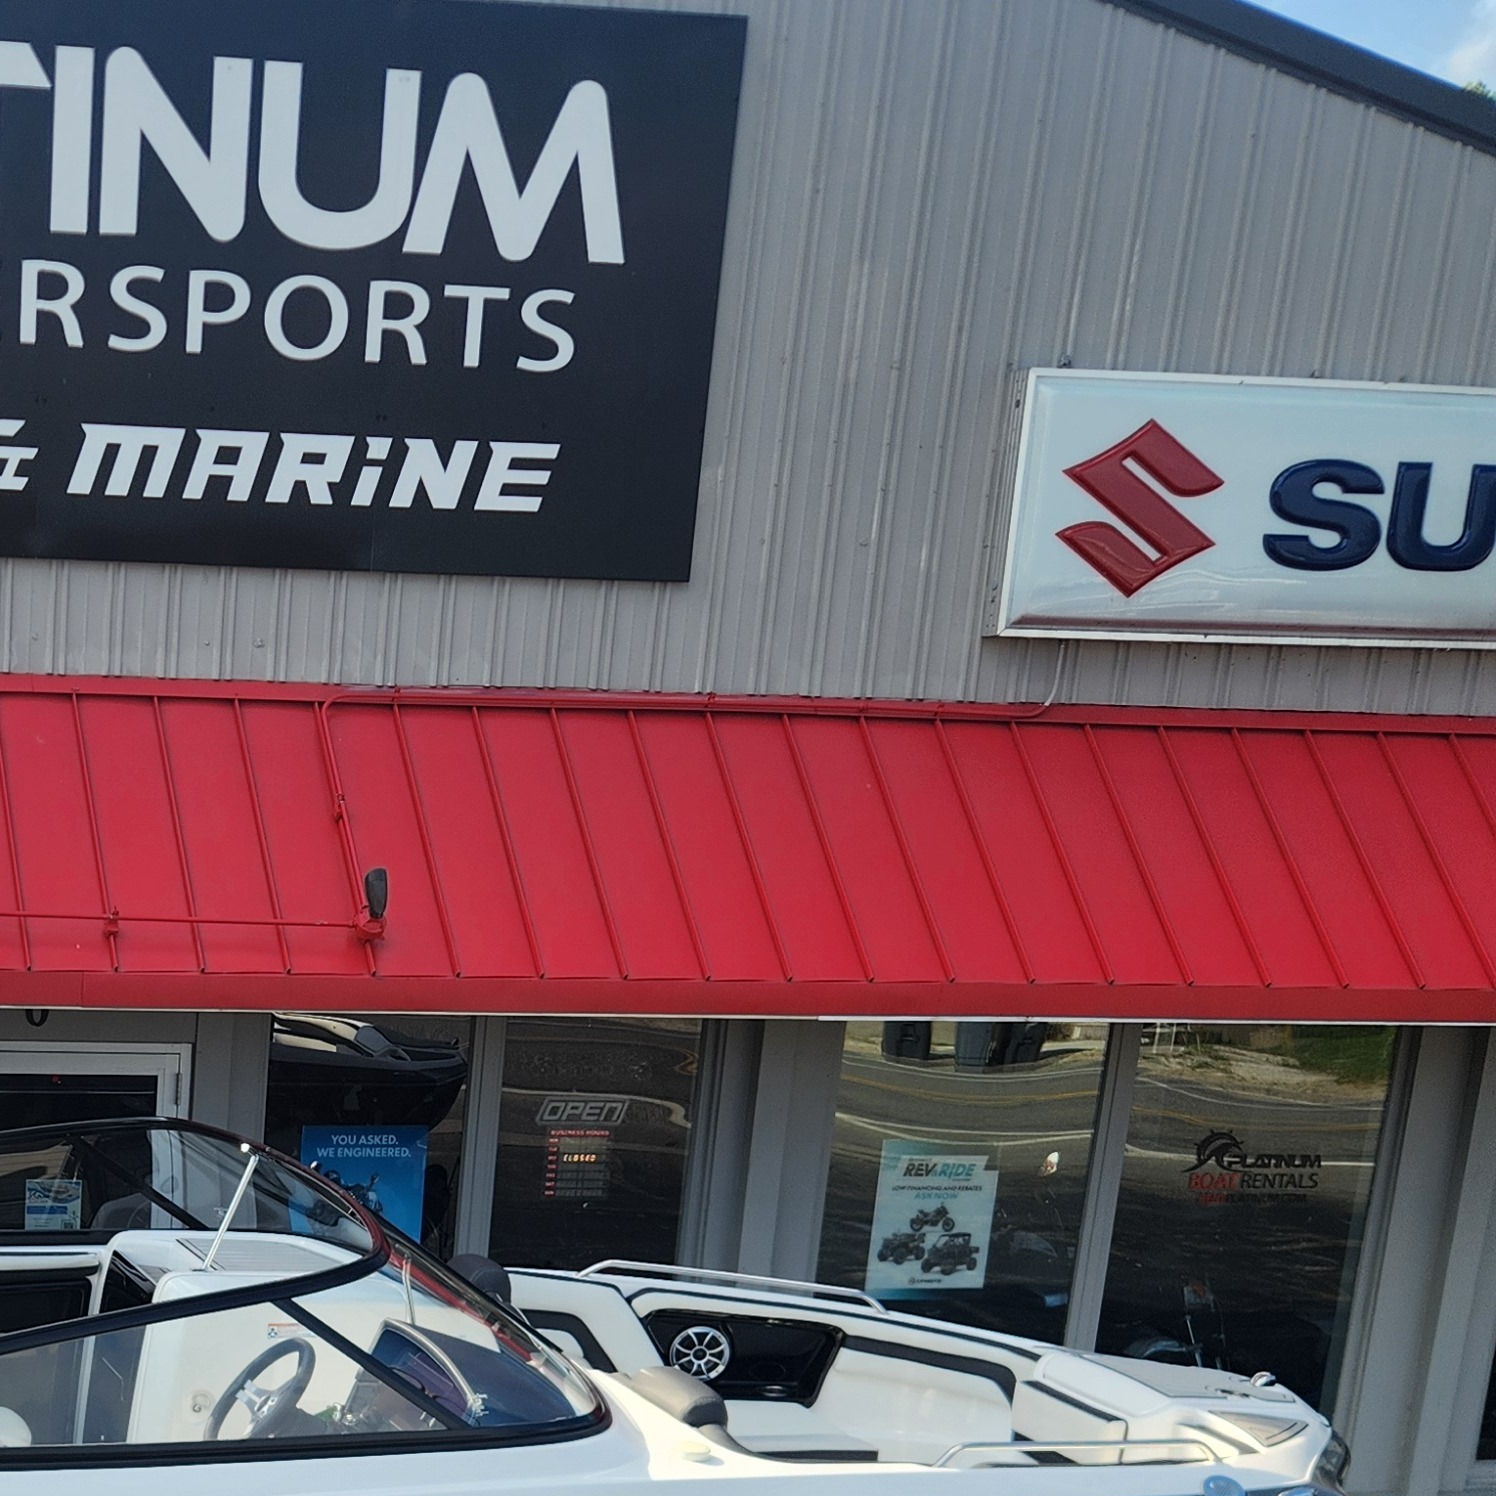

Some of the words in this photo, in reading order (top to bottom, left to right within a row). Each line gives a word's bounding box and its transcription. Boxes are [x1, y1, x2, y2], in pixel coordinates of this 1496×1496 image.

[1262, 458, 1496, 572] SU
[543, 1102, 623, 1121] OPEN
[331, 1134, 357, 1145] YOU
[358, 1134, 399, 1145] ASKED.
[317, 1147, 335, 1157] WE
[337, 1147, 411, 1158] ENGINEERED.
[1227, 1153, 1322, 1168] PLATINUM
[902, 1163, 937, 1177] REV
[938, 1163, 977, 1179] RIDE
[1188, 1172, 1240, 1191] BOAT
[1241, 1172, 1319, 1189] RENTALS
